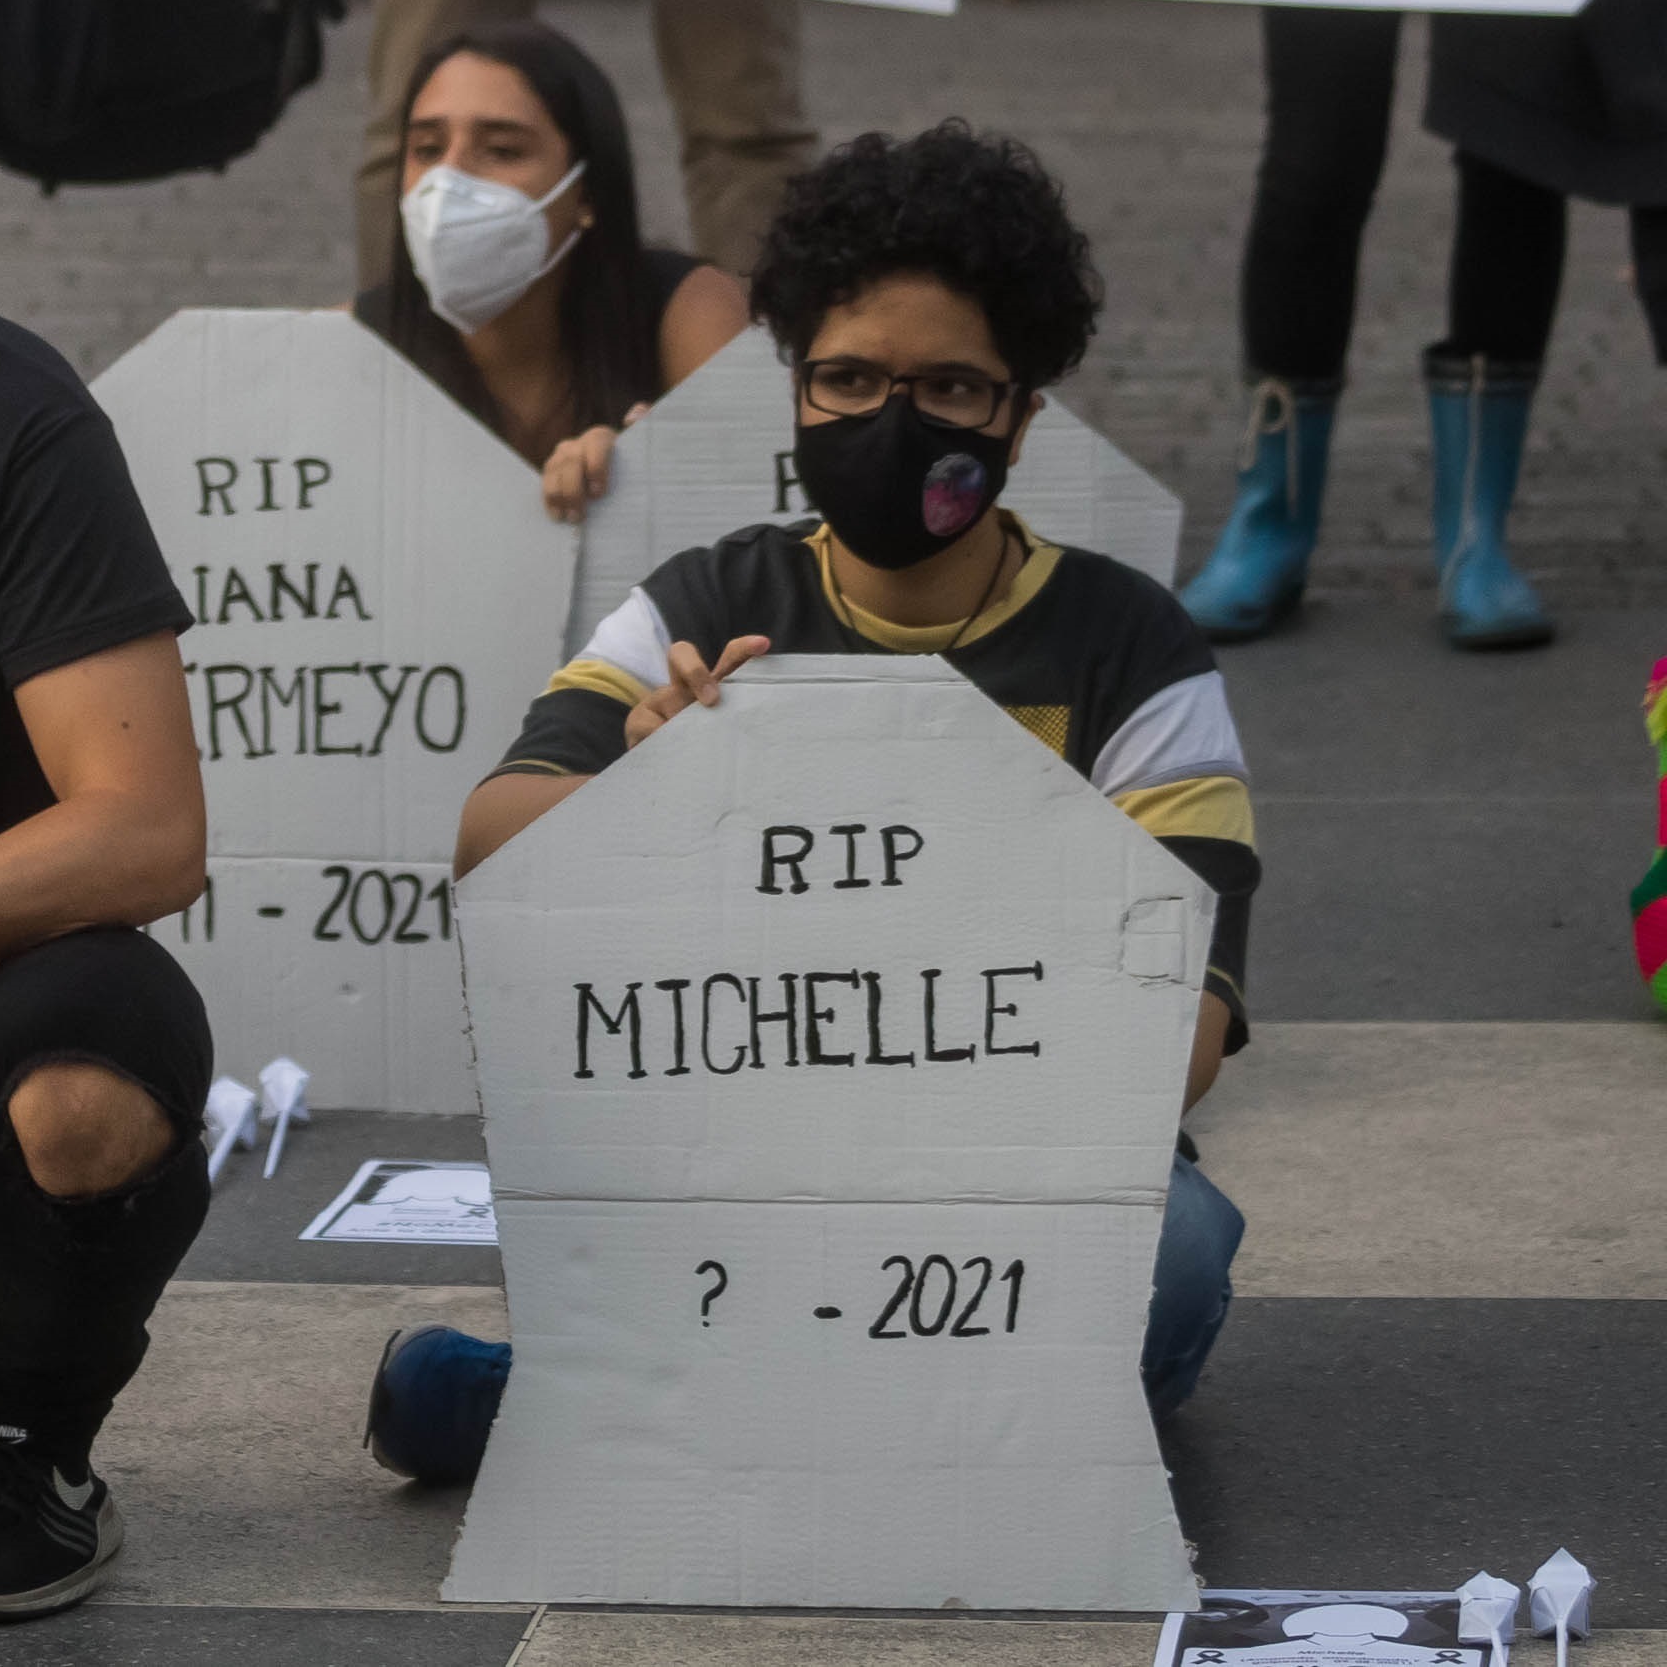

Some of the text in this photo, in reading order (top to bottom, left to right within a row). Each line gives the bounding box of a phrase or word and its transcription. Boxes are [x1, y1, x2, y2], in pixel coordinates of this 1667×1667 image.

[195, 458, 331, 516] RIP
[167, 562, 373, 626] IANA
[183, 660, 467, 763] RMEYO
[755, 824, 924, 895] RIP
[314, 866, 450, 945] 2021
[574, 961, 1043, 1079] MICHELLE
[869, 1255, 1024, 1339] 2021
